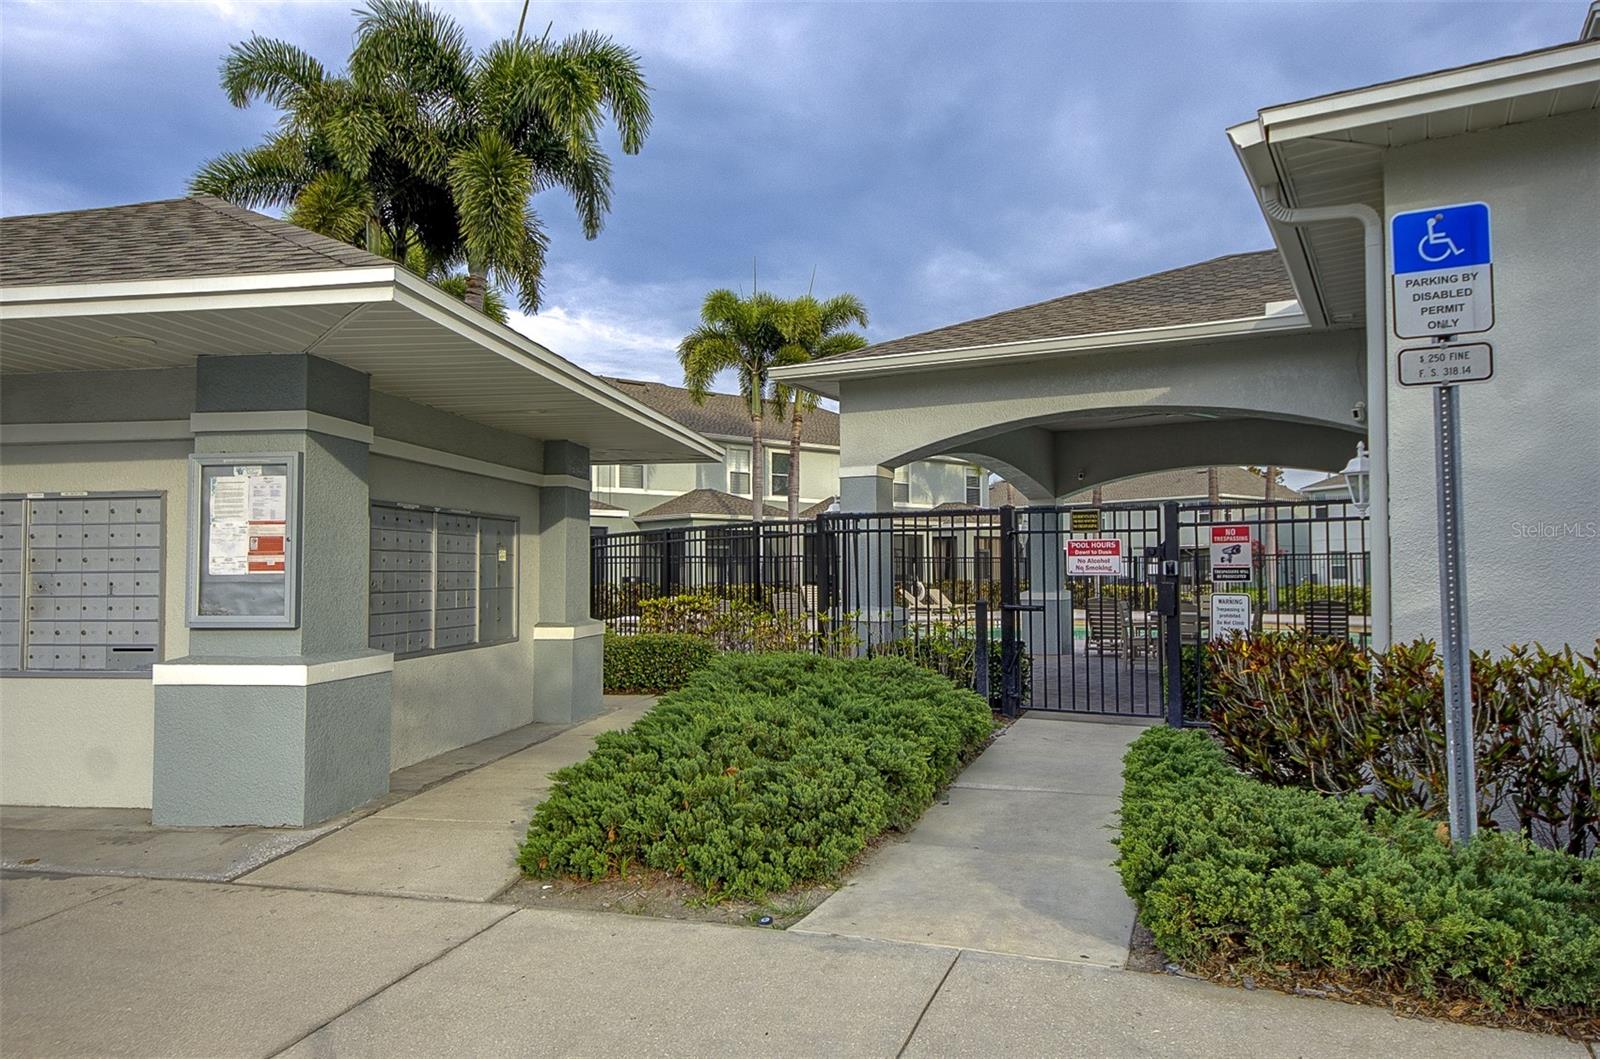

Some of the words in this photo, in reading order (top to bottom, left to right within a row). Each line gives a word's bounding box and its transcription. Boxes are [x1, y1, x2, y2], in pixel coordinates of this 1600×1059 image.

[1405, 274, 1458, 288] PARKING
[1462, 272, 1479, 282] BY
[1412, 288, 1473, 302] DISABLED
[1420, 303, 1465, 316] PERMIT
[1427, 318, 1460, 330] ONLY
[1428, 353, 1446, 363] 250
[1449, 351, 1470, 361] FINE
[1443, 366, 1471, 376] 318.14
[1225, 528, 1236, 536] NO
[1091, 541, 1116, 549] HOURS
